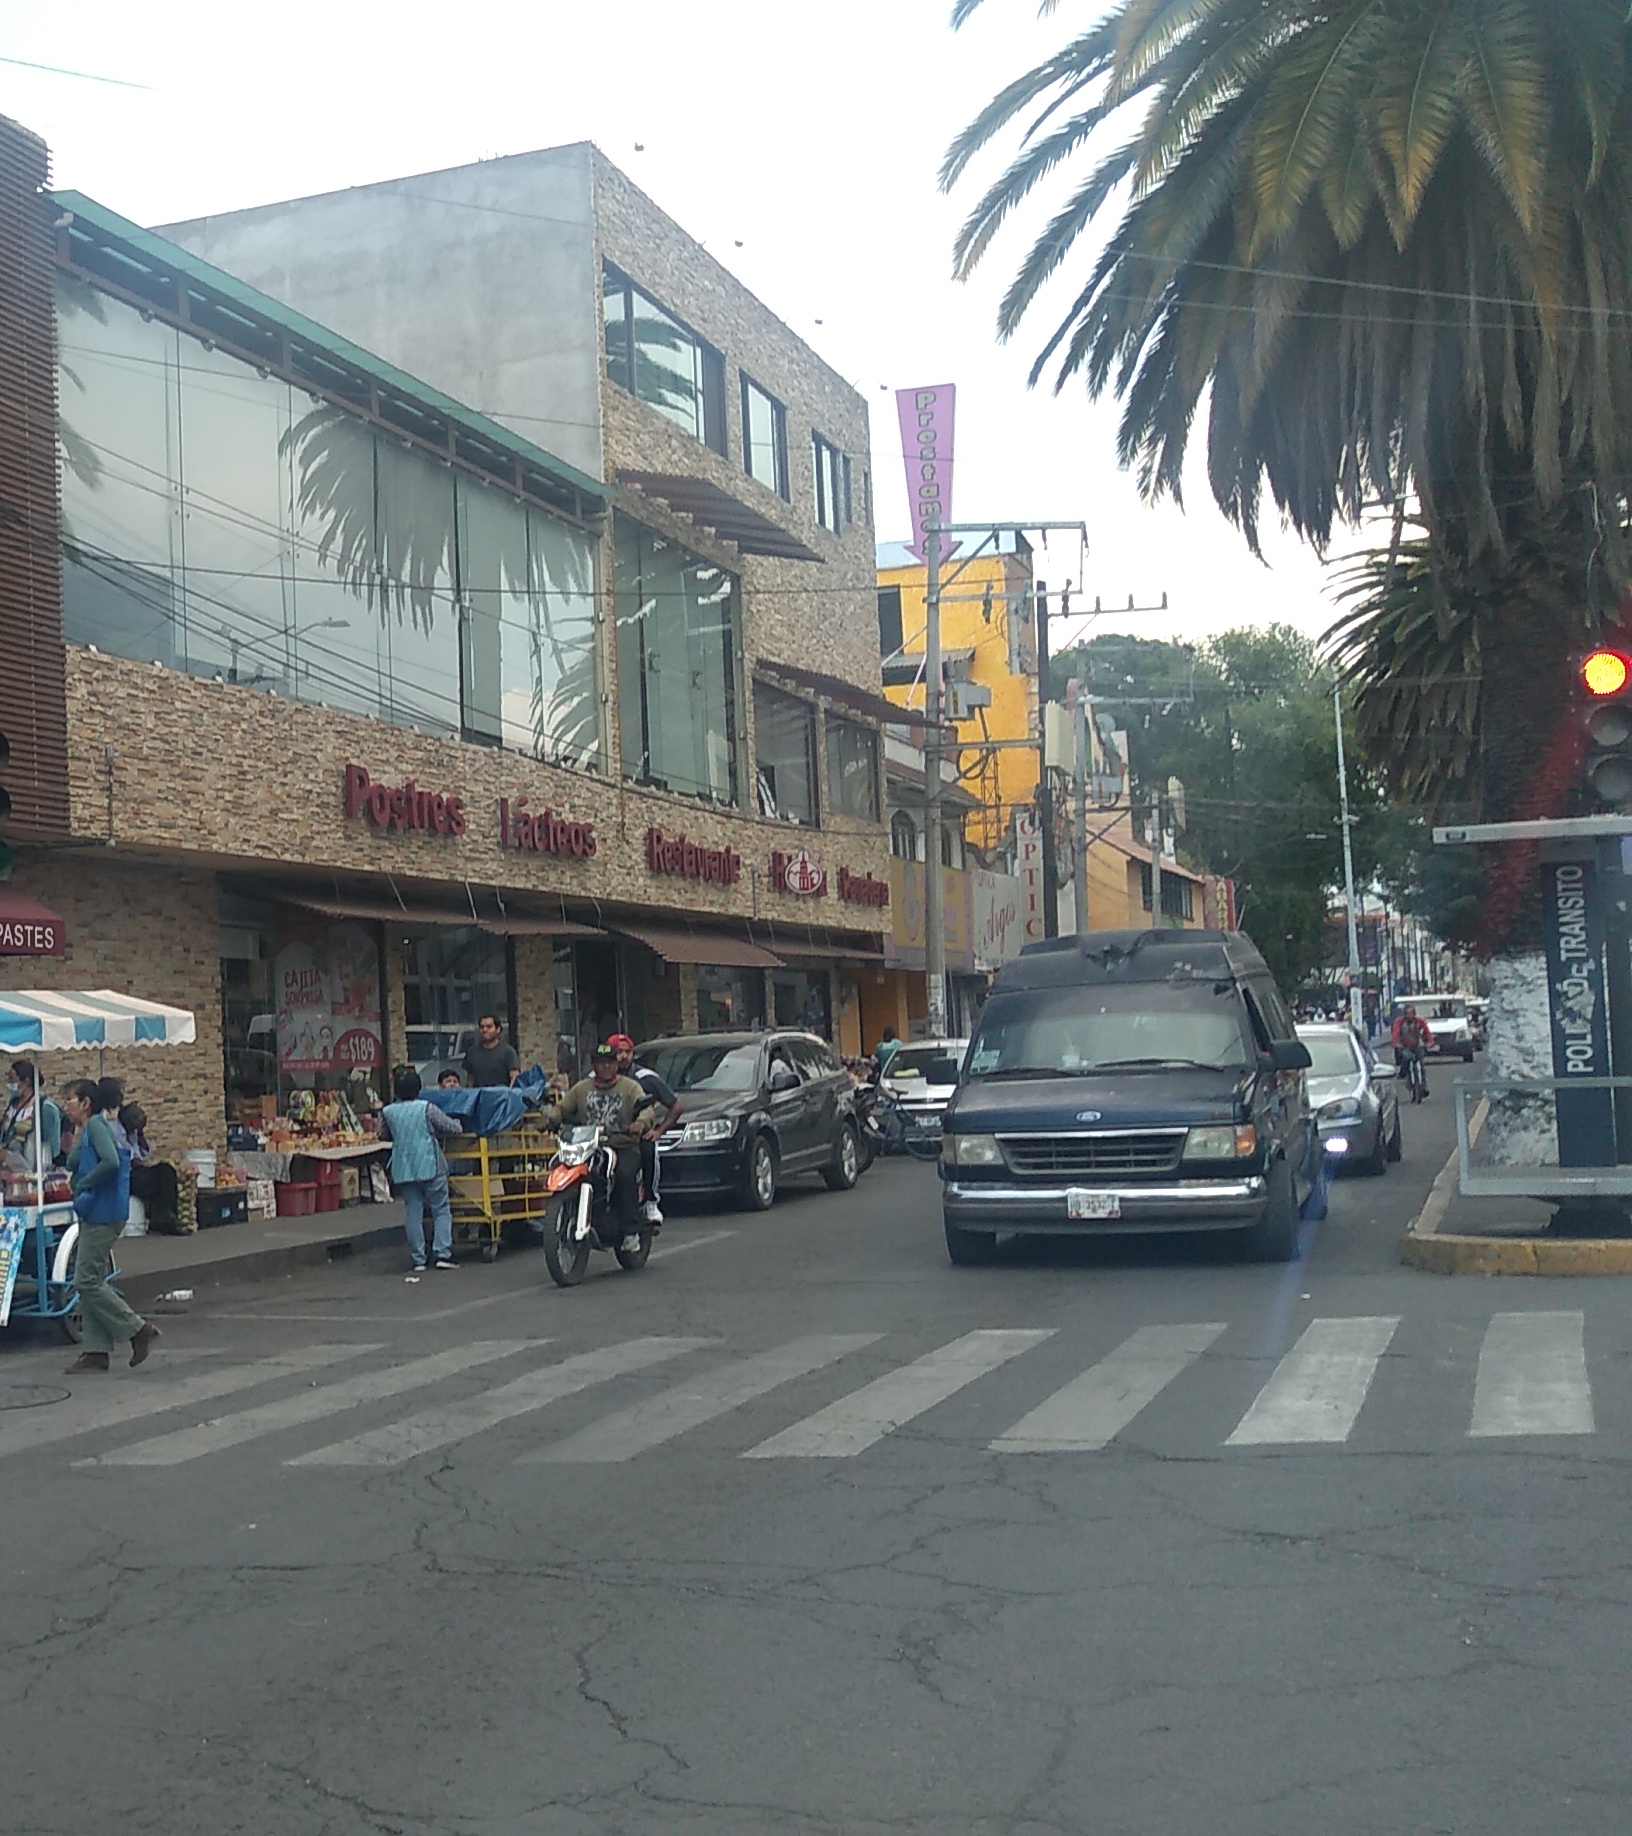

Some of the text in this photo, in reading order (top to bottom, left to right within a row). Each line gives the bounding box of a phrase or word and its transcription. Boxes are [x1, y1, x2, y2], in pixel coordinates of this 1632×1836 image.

[344, 764, 466, 837] Postres
[647, 827, 741, 885] Restaurante
[1555, 865, 1588, 963] TRANSITO
[284, 968, 322, 991] CAJITA
[349, 1036, 375, 1062] $189
